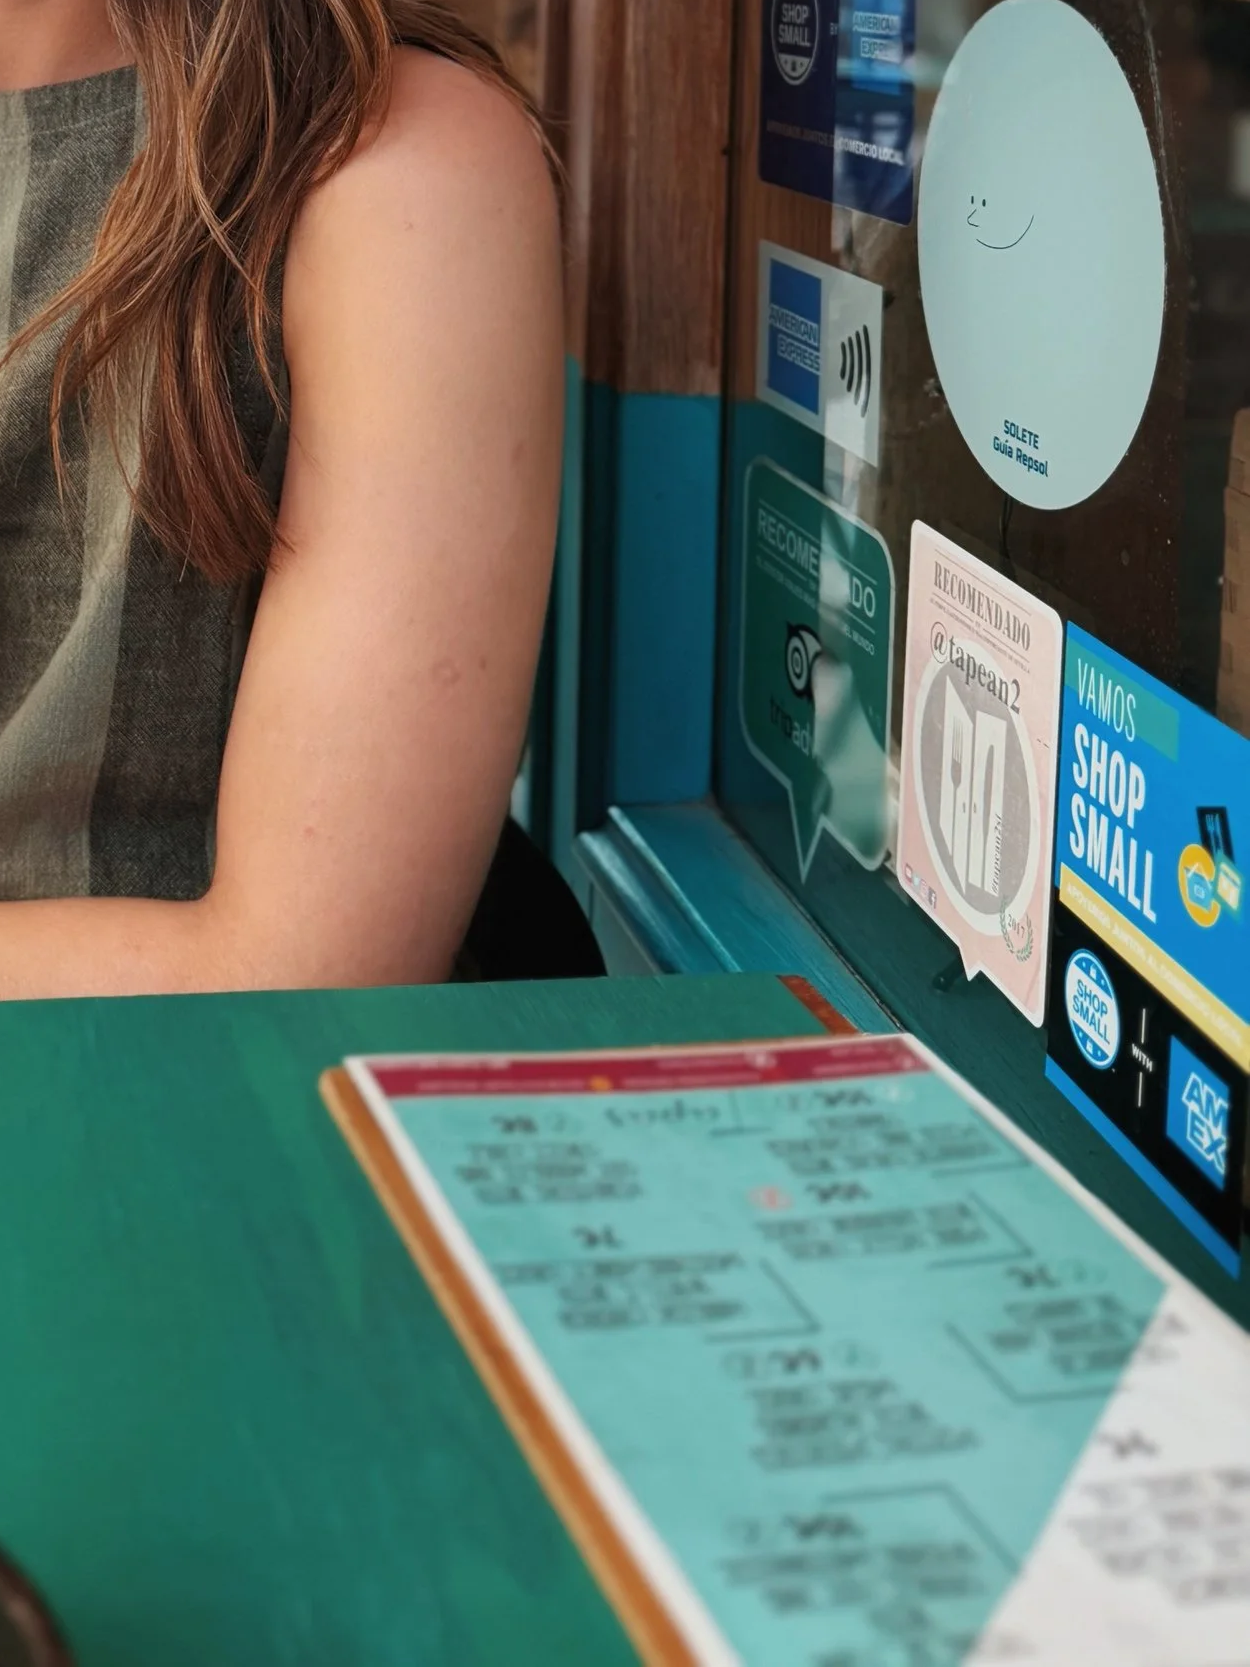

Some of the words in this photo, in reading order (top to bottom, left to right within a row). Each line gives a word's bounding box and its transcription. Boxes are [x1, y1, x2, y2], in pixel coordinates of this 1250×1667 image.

[778, 24, 811, 47] SMALL
[781, 3, 809, 24] SHOP
[769, 302, 819, 348] AMERICAN
[777, 333, 822, 376] EXPRESS
[993, 435, 1013, 459] Guía
[1015, 447, 1049, 478] Repsol
[1003, 419, 1040, 450] SOLETE
[758, 508, 877, 618] RECOMEDO
[934, 561, 1031, 652] RECOMENDADO
[930, 621, 1021, 715] @tapean2
[1077, 658, 1137, 743] VAMOS
[1072, 722, 1147, 830] SHOP
[1069, 792, 1158, 924] SMALL
[1007, 913, 1026, 939] 2017
[1072, 994, 1111, 1045] SMALL
[1076, 979, 1108, 1018] SHOP
[1131, 1042, 1153, 1072] WITH
[1182, 1072, 1230, 1135] AM
[1186, 1106, 1227, 1176] EX
